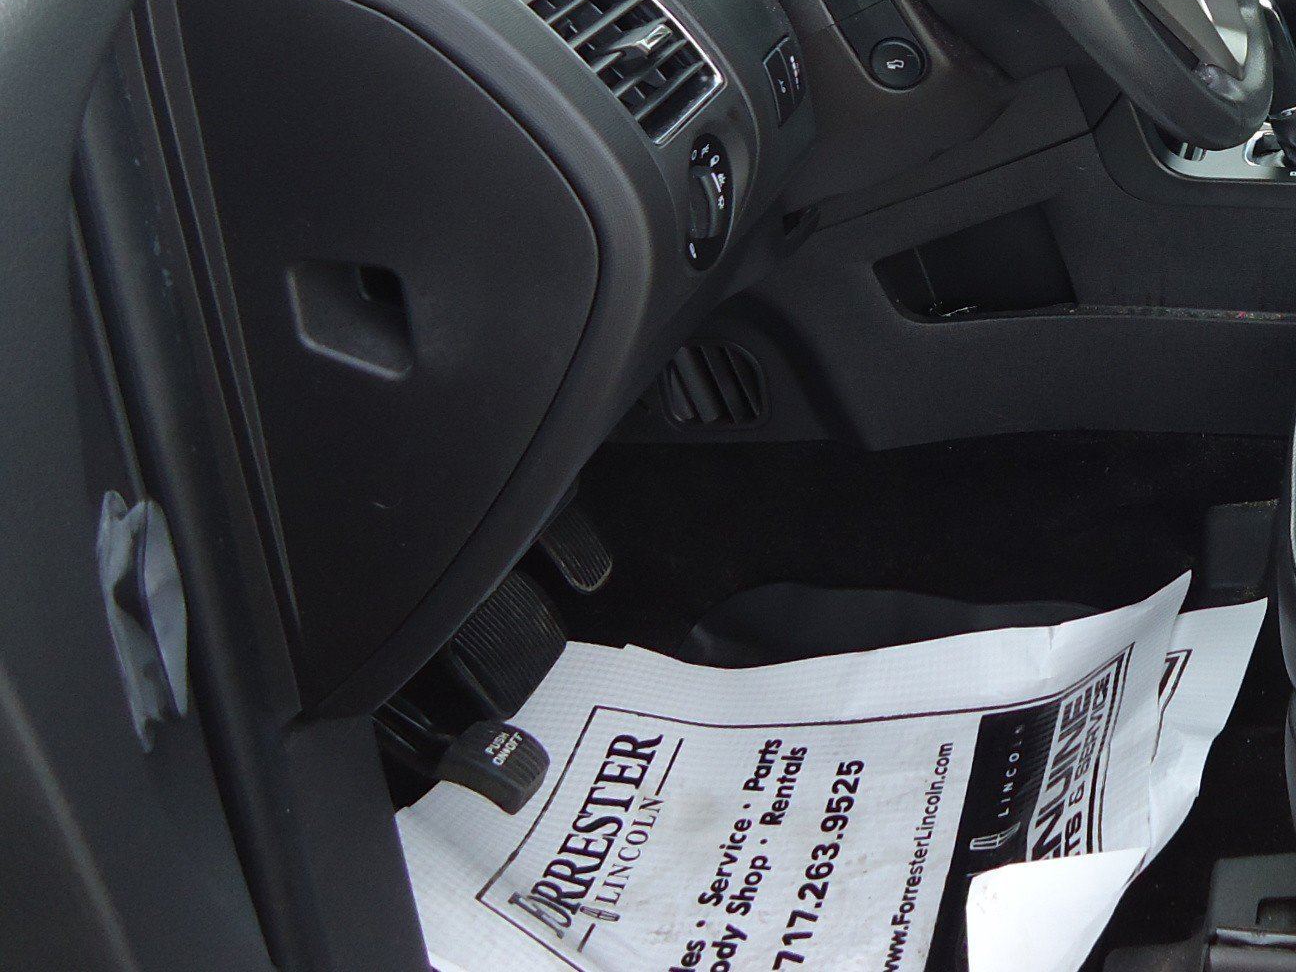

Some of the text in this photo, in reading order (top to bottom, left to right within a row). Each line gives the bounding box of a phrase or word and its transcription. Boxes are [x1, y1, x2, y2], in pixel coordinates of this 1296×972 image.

[484, 731, 510, 755] PUSH
[1031, 686, 1093, 861] NUINE
[1069, 781, 1086, 807] &
[1074, 672, 1112, 781] SERVICE
[595, 795, 664, 906] LINCOLN
[668, 738, 783, 972] les Service Parts
[709, 746, 808, 972] ody Shop Rentals
[772, 759, 865, 971] 717.263.9525
